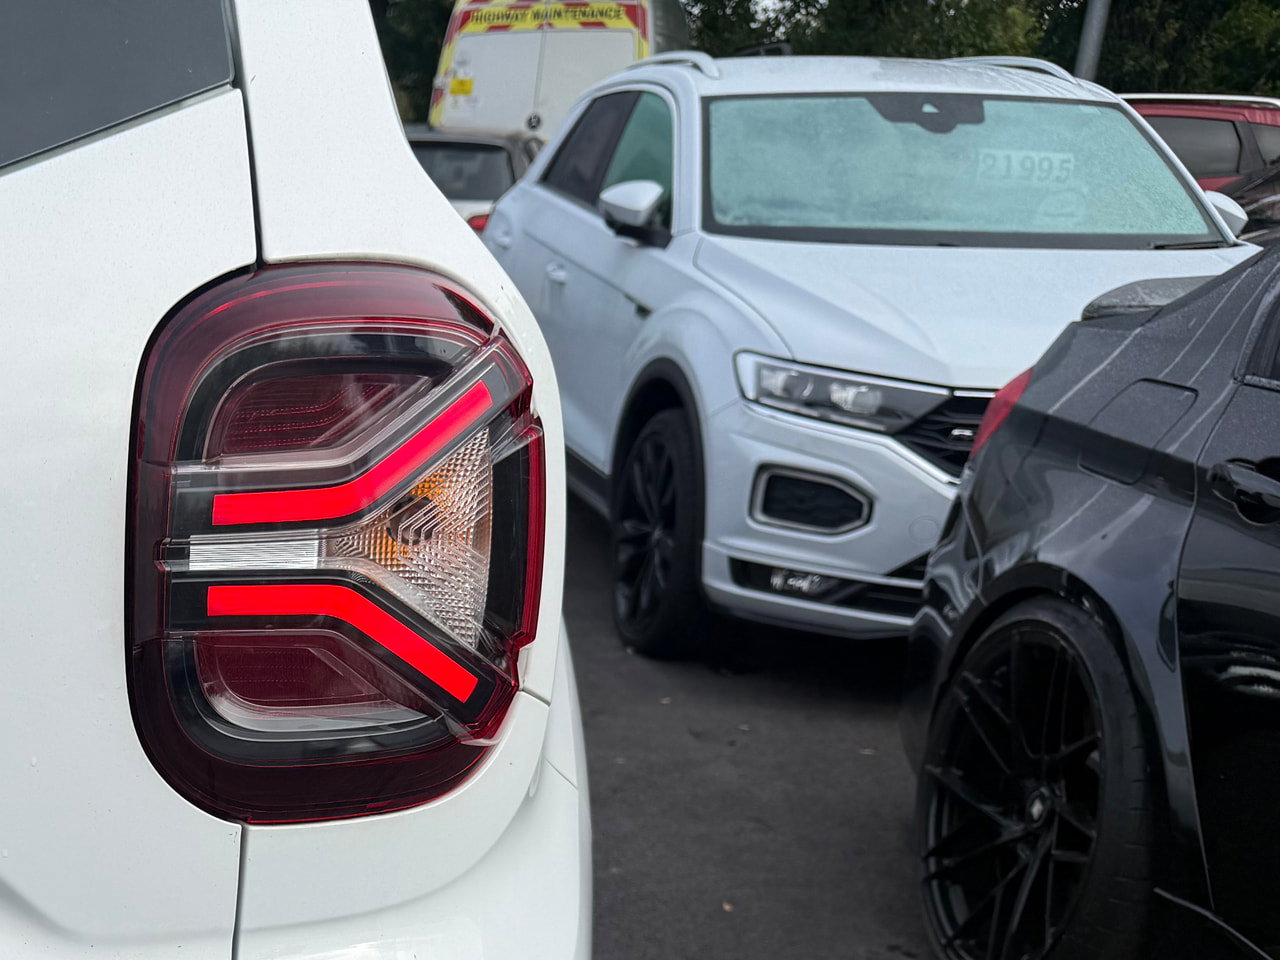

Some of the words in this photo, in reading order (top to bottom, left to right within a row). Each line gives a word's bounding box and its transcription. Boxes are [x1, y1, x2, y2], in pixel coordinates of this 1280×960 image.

[470, 8, 527, 23] HIGHWAY
[532, 7, 624, 22] MAINTENANCE
[981, 152, 1073, 183] 21995
